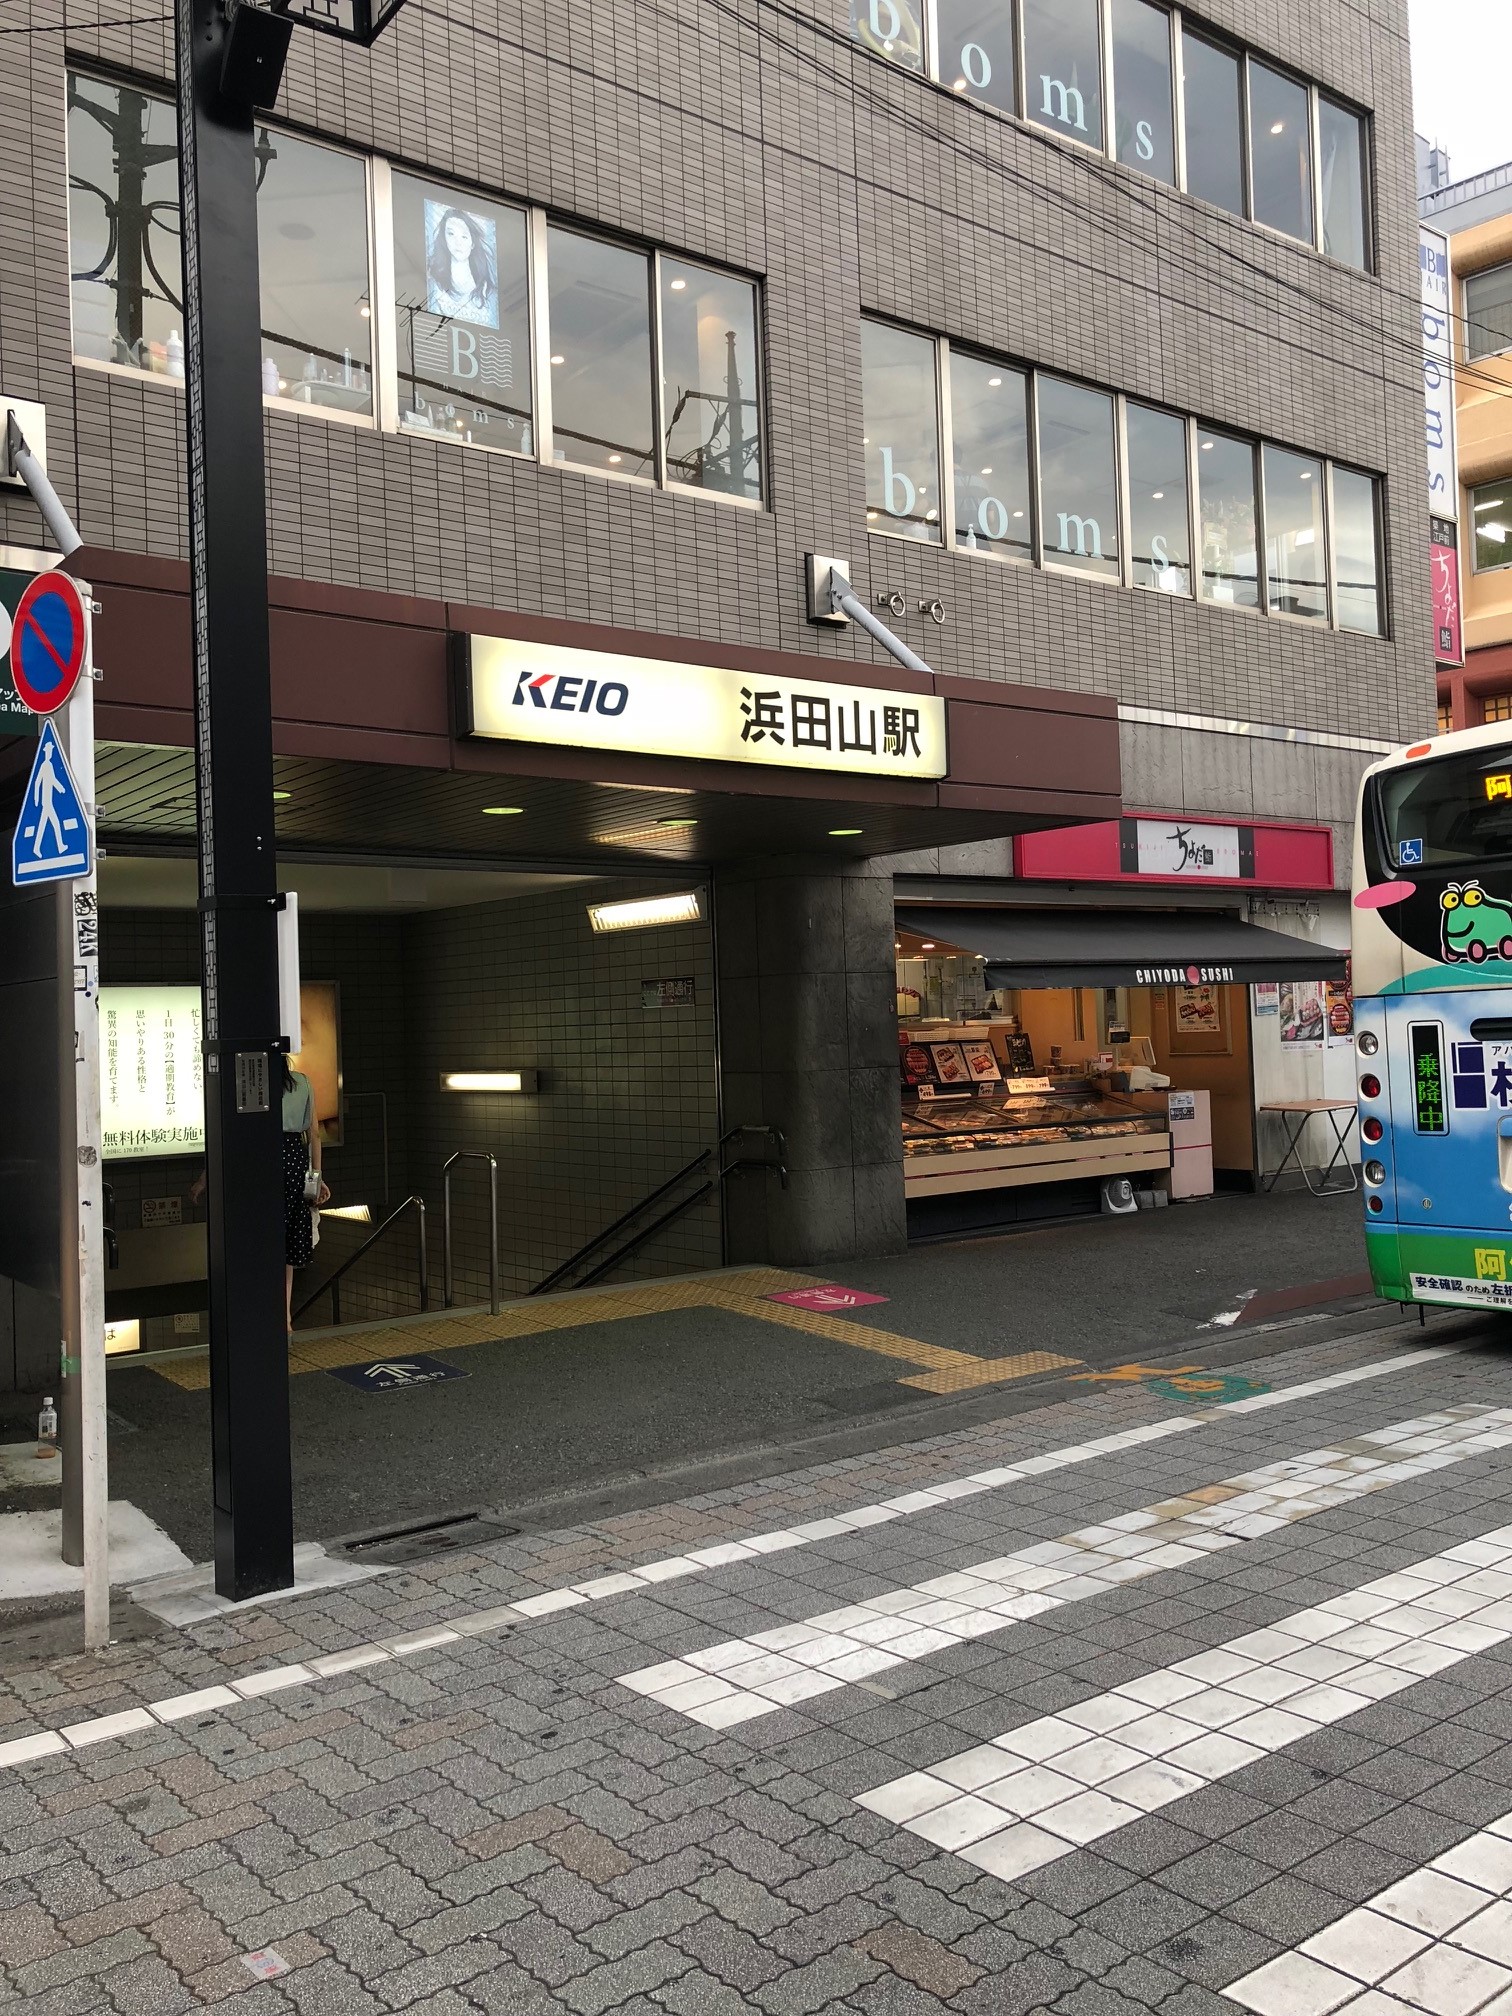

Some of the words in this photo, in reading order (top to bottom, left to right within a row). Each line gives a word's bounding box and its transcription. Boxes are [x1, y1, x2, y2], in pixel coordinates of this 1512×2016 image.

[450, 325, 479, 379] B
[878, 446, 1169, 574] boms
[511, 671, 629, 716] KEIO
[739, 686, 922, 758] 浜田山駅
[1135, 968, 1186, 984] CHIYODA
[1200, 967, 1234, 982] SUSHI
[1416, 1052, 1443, 1131] 乗降中
